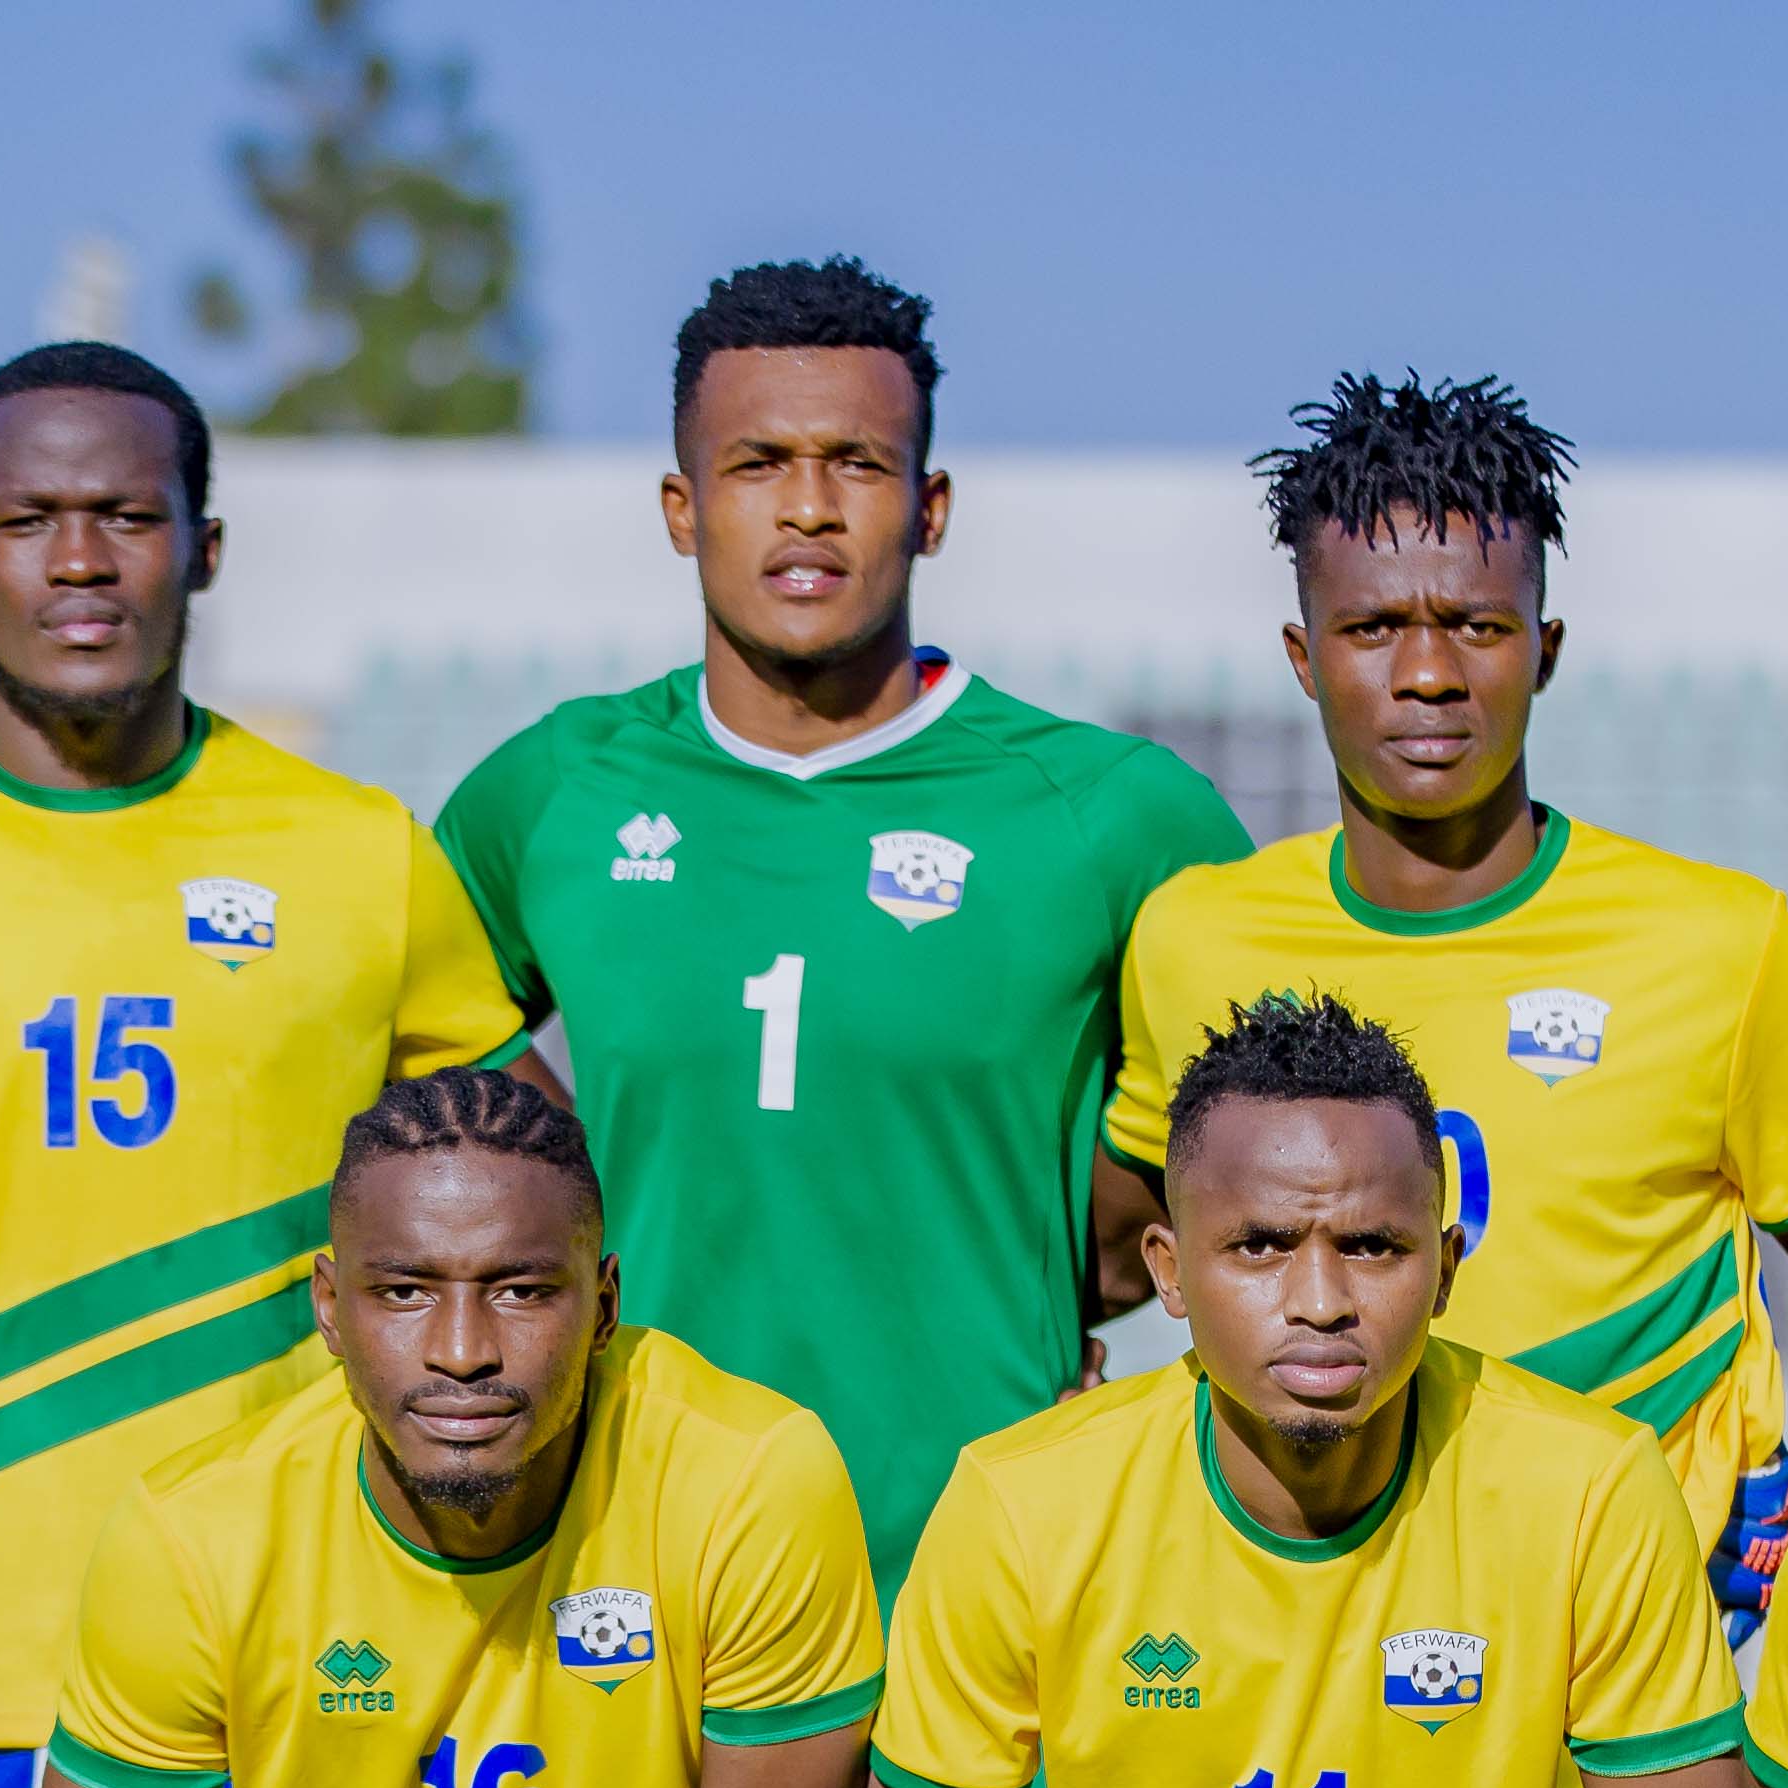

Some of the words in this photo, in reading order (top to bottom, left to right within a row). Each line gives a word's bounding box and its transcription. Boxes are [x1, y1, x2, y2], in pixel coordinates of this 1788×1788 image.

[610, 856, 676, 883] errea
[743, 953, 806, 1112] 1
[20, 995, 178, 1149] 15
[556, 1588, 645, 1616] FERWAFA
[1388, 1630, 1478, 1655] FERWAFA
[318, 1690, 396, 1713] errea
[1123, 1685, 1201, 1710] errea
